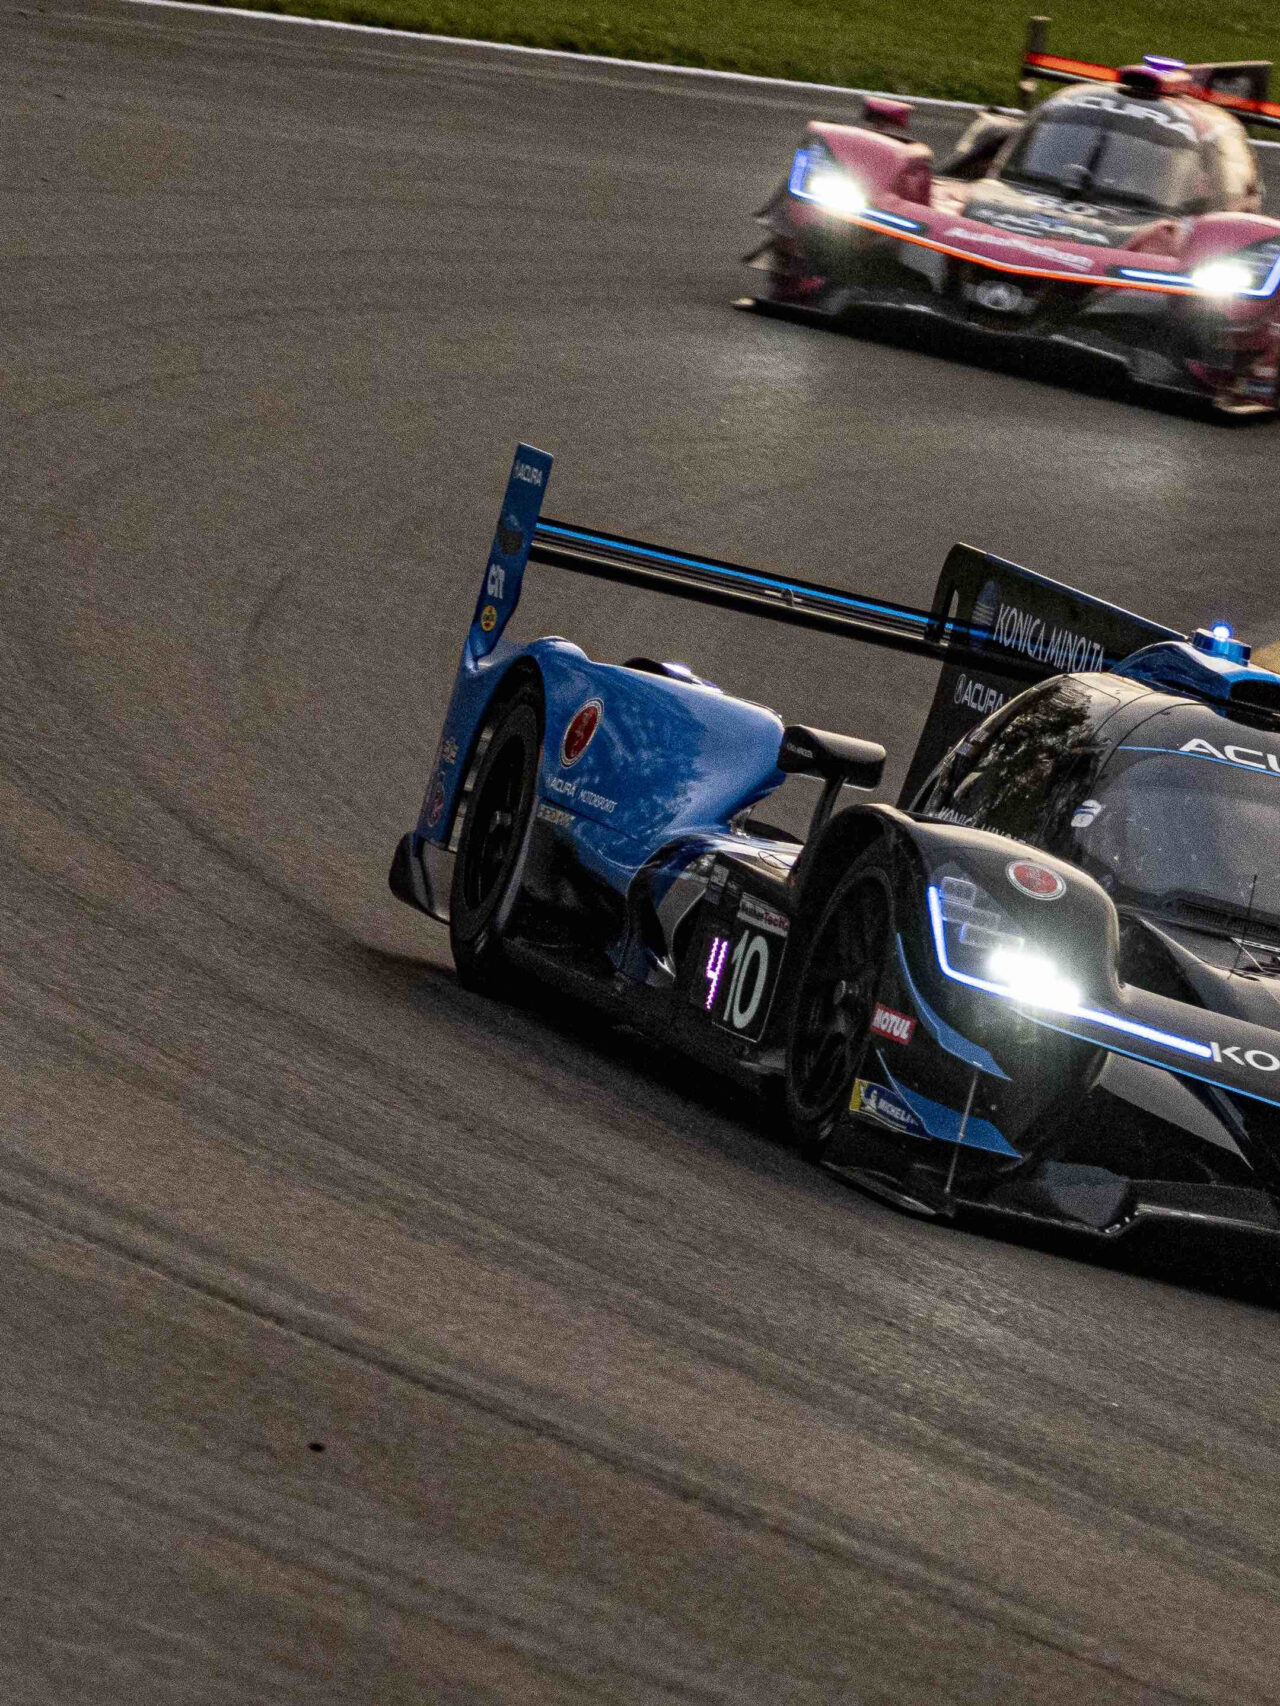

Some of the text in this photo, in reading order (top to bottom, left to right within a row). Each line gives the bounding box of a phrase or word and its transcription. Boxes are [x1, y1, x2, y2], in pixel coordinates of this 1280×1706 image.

[993, 602, 1105, 674] KONICA MINOLTA
[961, 679, 1003, 715] ACURA
[705, 935, 729, 1011] 4
[722, 928, 769, 1030] 10
[871, 1007, 912, 1041] MOTUL
